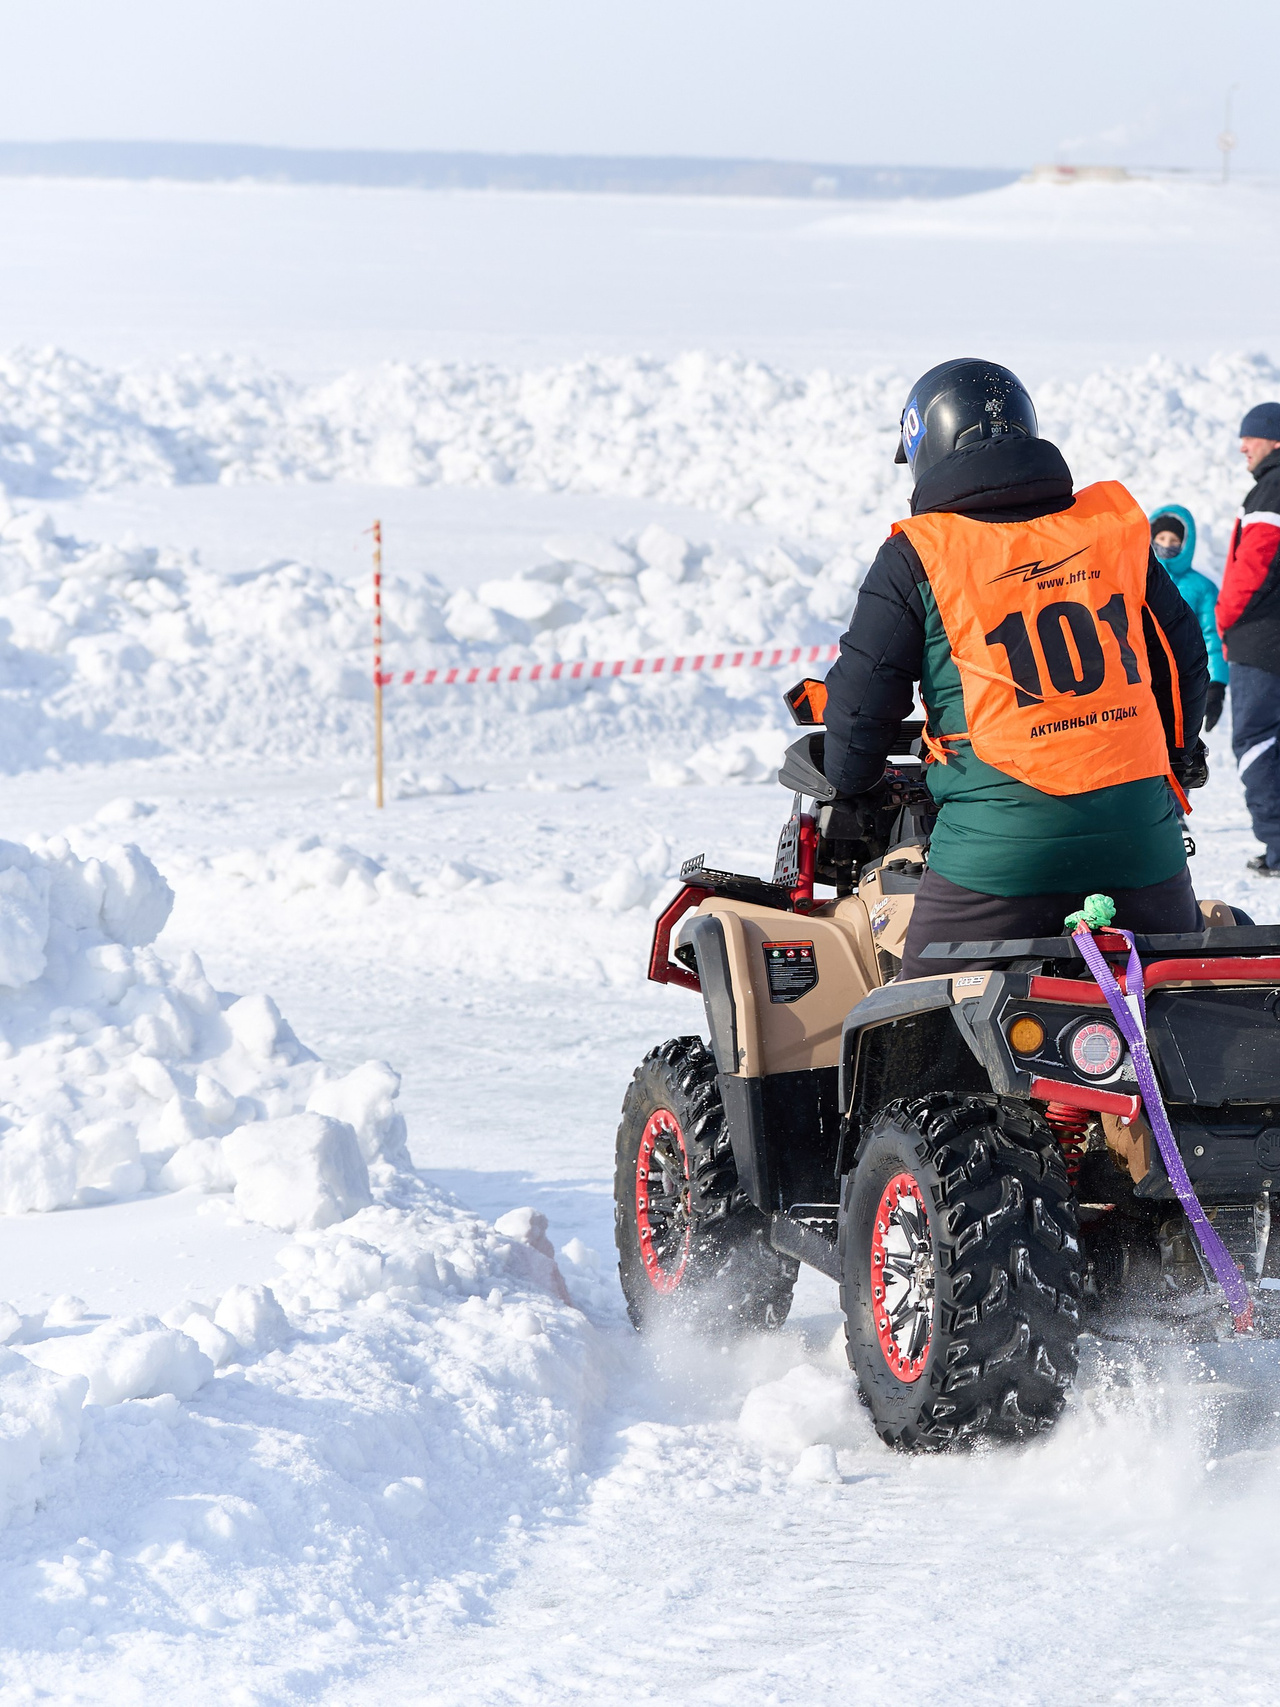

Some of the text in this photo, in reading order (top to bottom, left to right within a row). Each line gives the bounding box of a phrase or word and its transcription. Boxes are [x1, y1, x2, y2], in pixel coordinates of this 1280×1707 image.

[1037, 569, 1101, 590] www.hft.ru
[984, 593, 1142, 708] 101
[1030, 706, 1138, 738] АКТИВНЫЙ ОТДЫХ
